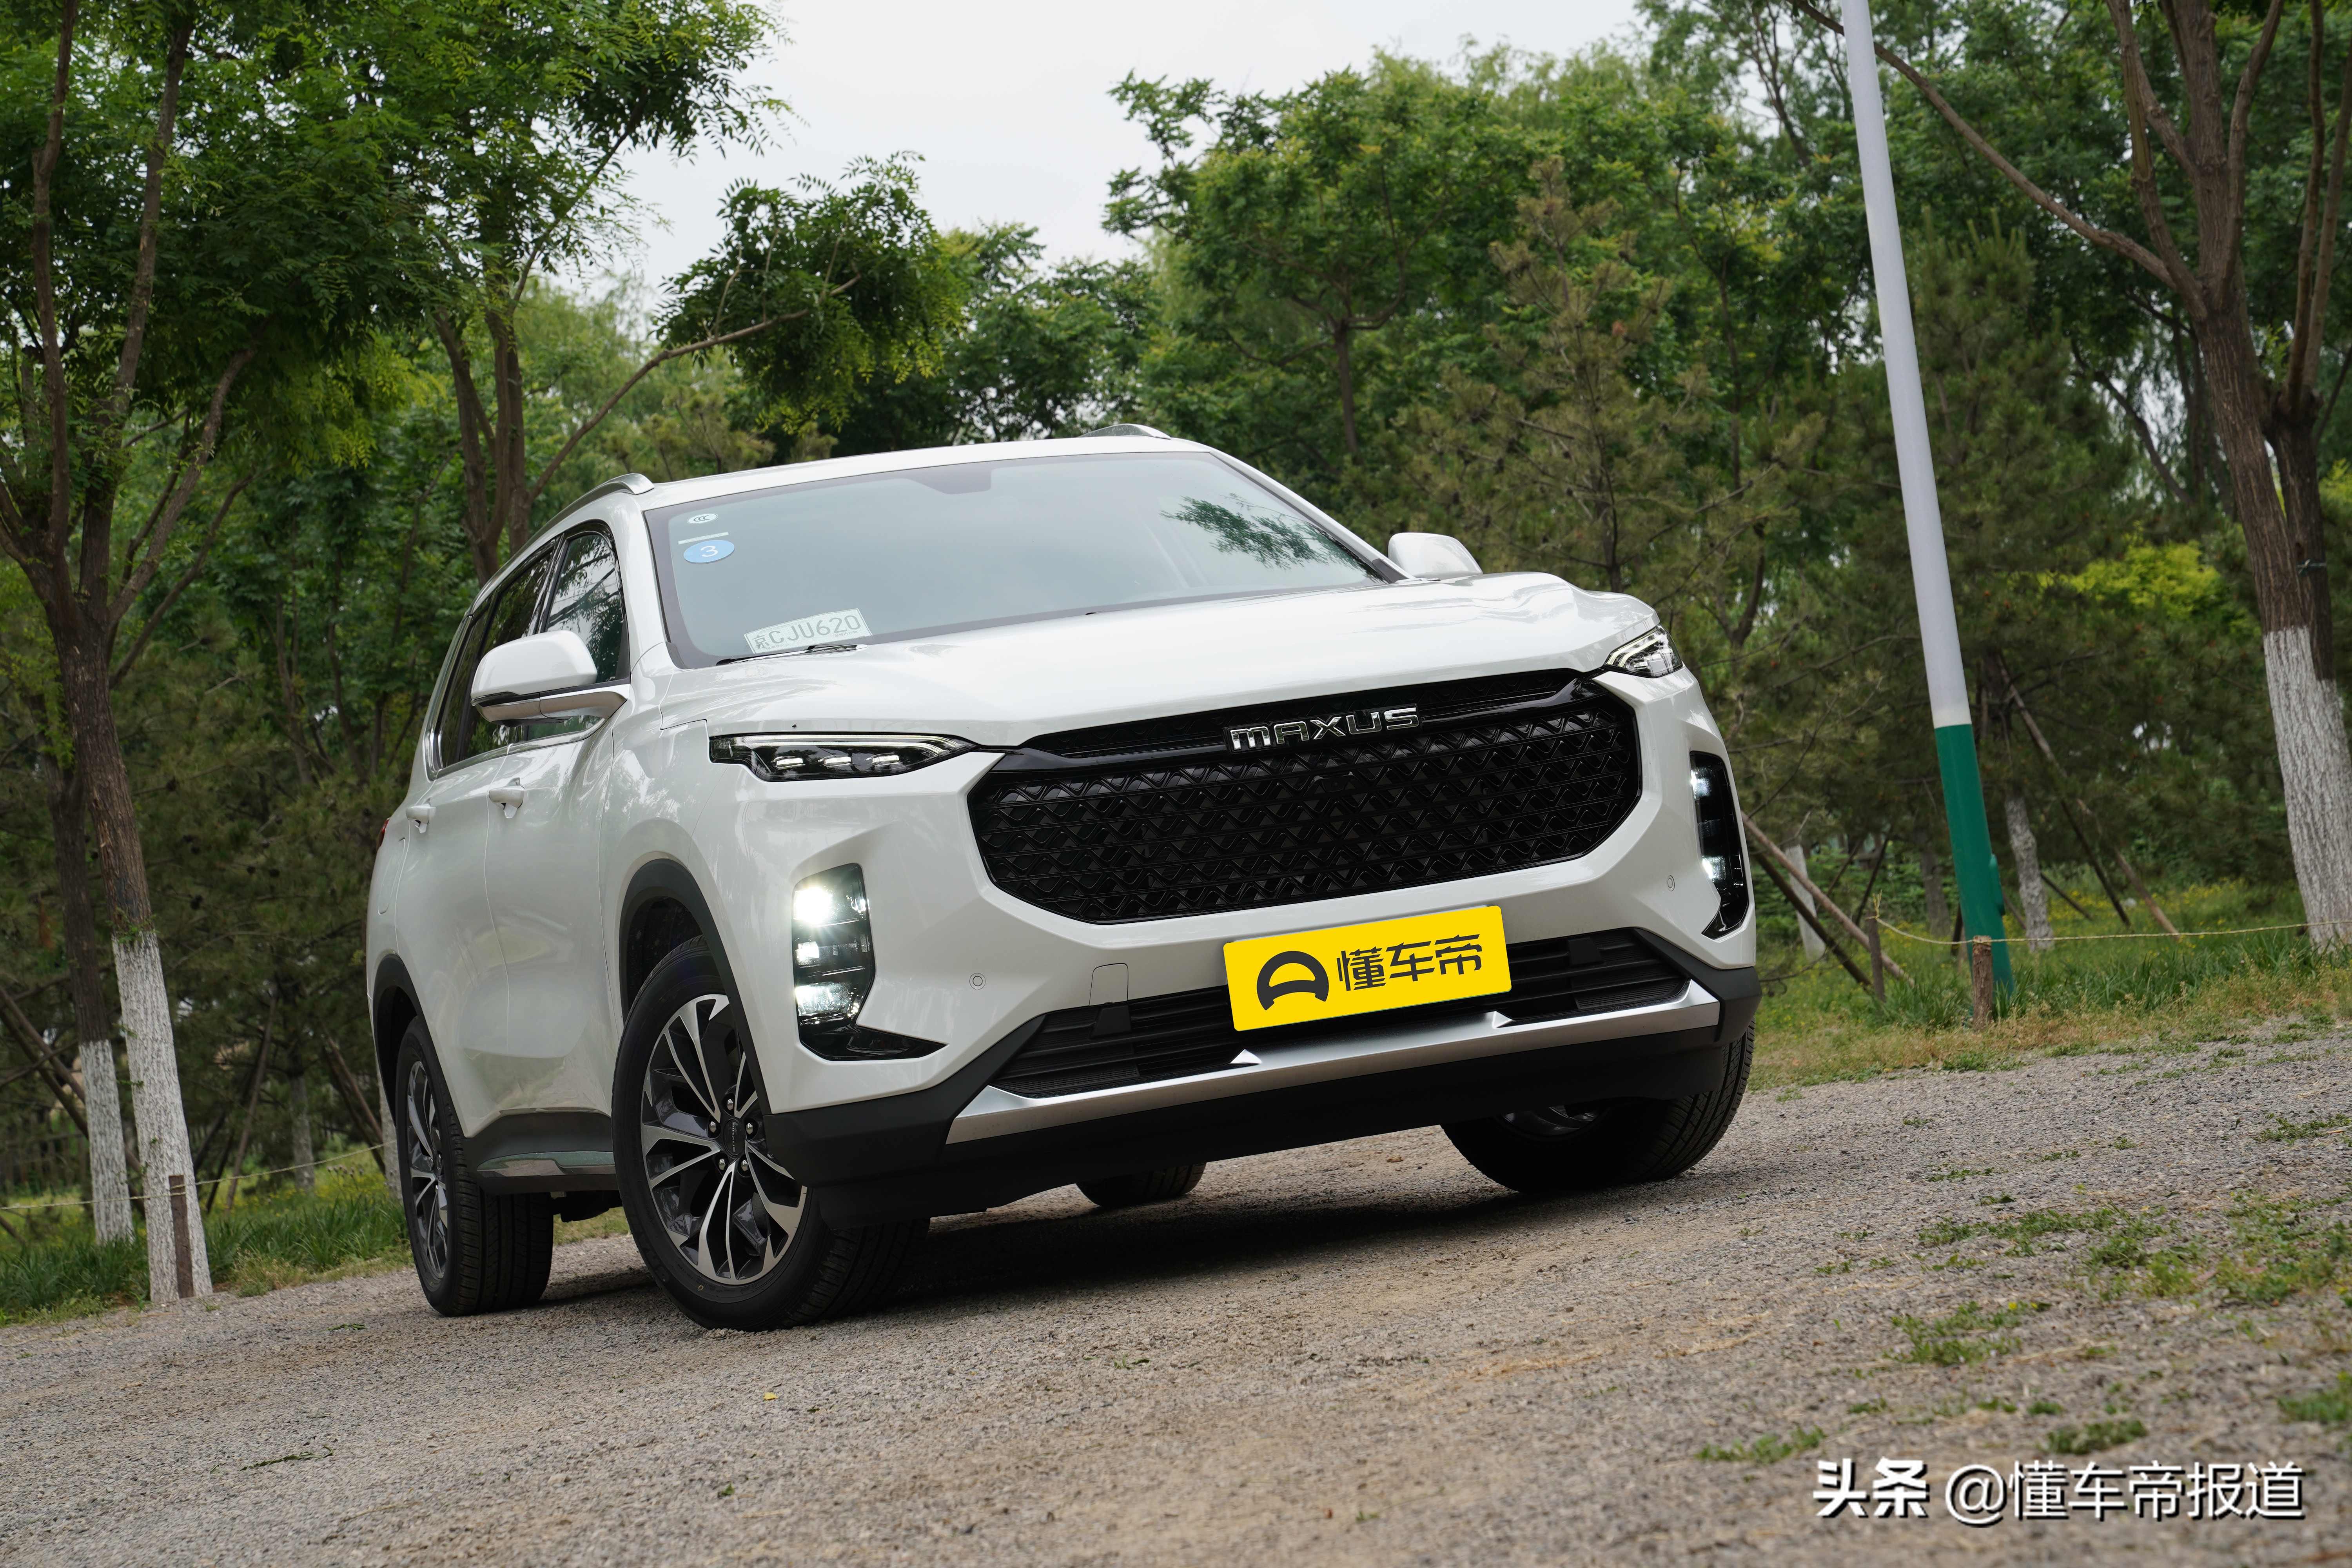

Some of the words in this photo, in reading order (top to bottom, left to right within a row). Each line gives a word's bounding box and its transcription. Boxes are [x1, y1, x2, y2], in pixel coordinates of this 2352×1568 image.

[700, 545, 718, 557] 3
[752, 615, 861, 648] 京CJU620
[1230, 707, 1419, 750] MAXUS
